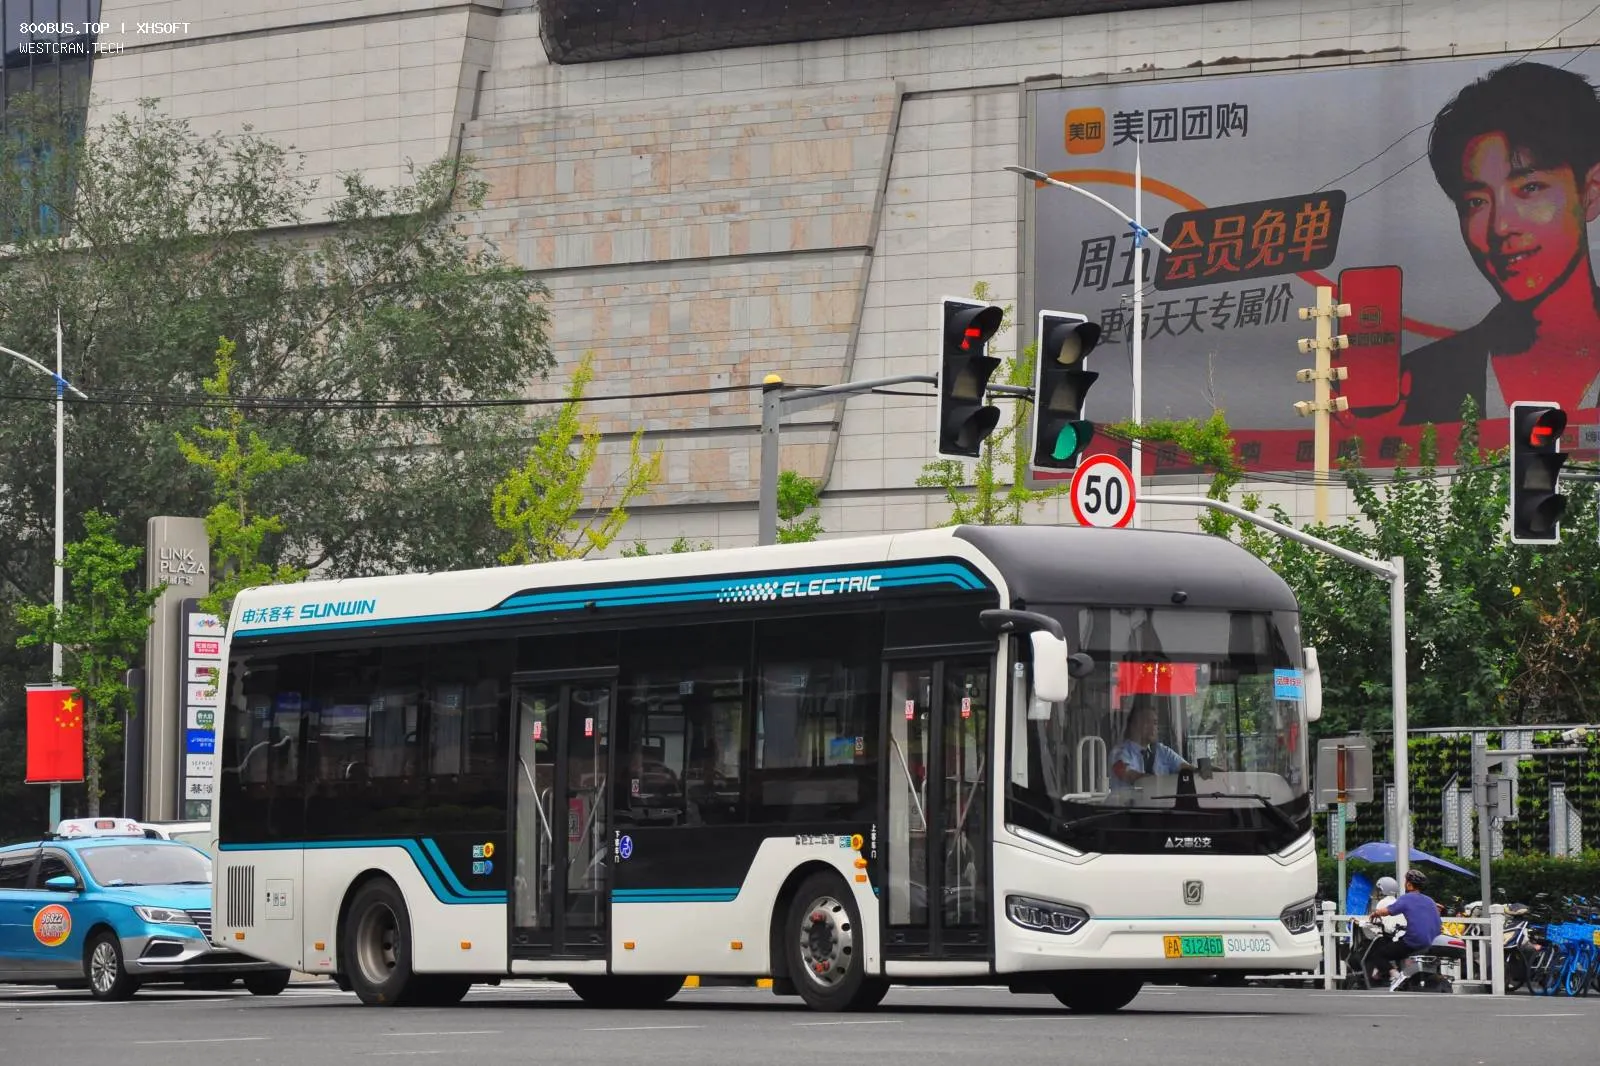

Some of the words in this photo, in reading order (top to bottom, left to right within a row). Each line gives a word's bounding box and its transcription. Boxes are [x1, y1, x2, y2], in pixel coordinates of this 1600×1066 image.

[1068, 121, 1101, 141] 美团
[1112, 102, 1249, 146] 美团团购
[1164, 200, 1333, 281] 会员免单
[1084, 474, 1123, 515] 50
[160, 546, 195, 561] LINK
[160, 560, 207, 575] PLAZA
[781, 574, 882, 598] ELECTRIC
[242, 605, 295, 624] 申沃客车
[300, 599, 376, 620] SUNWIN
